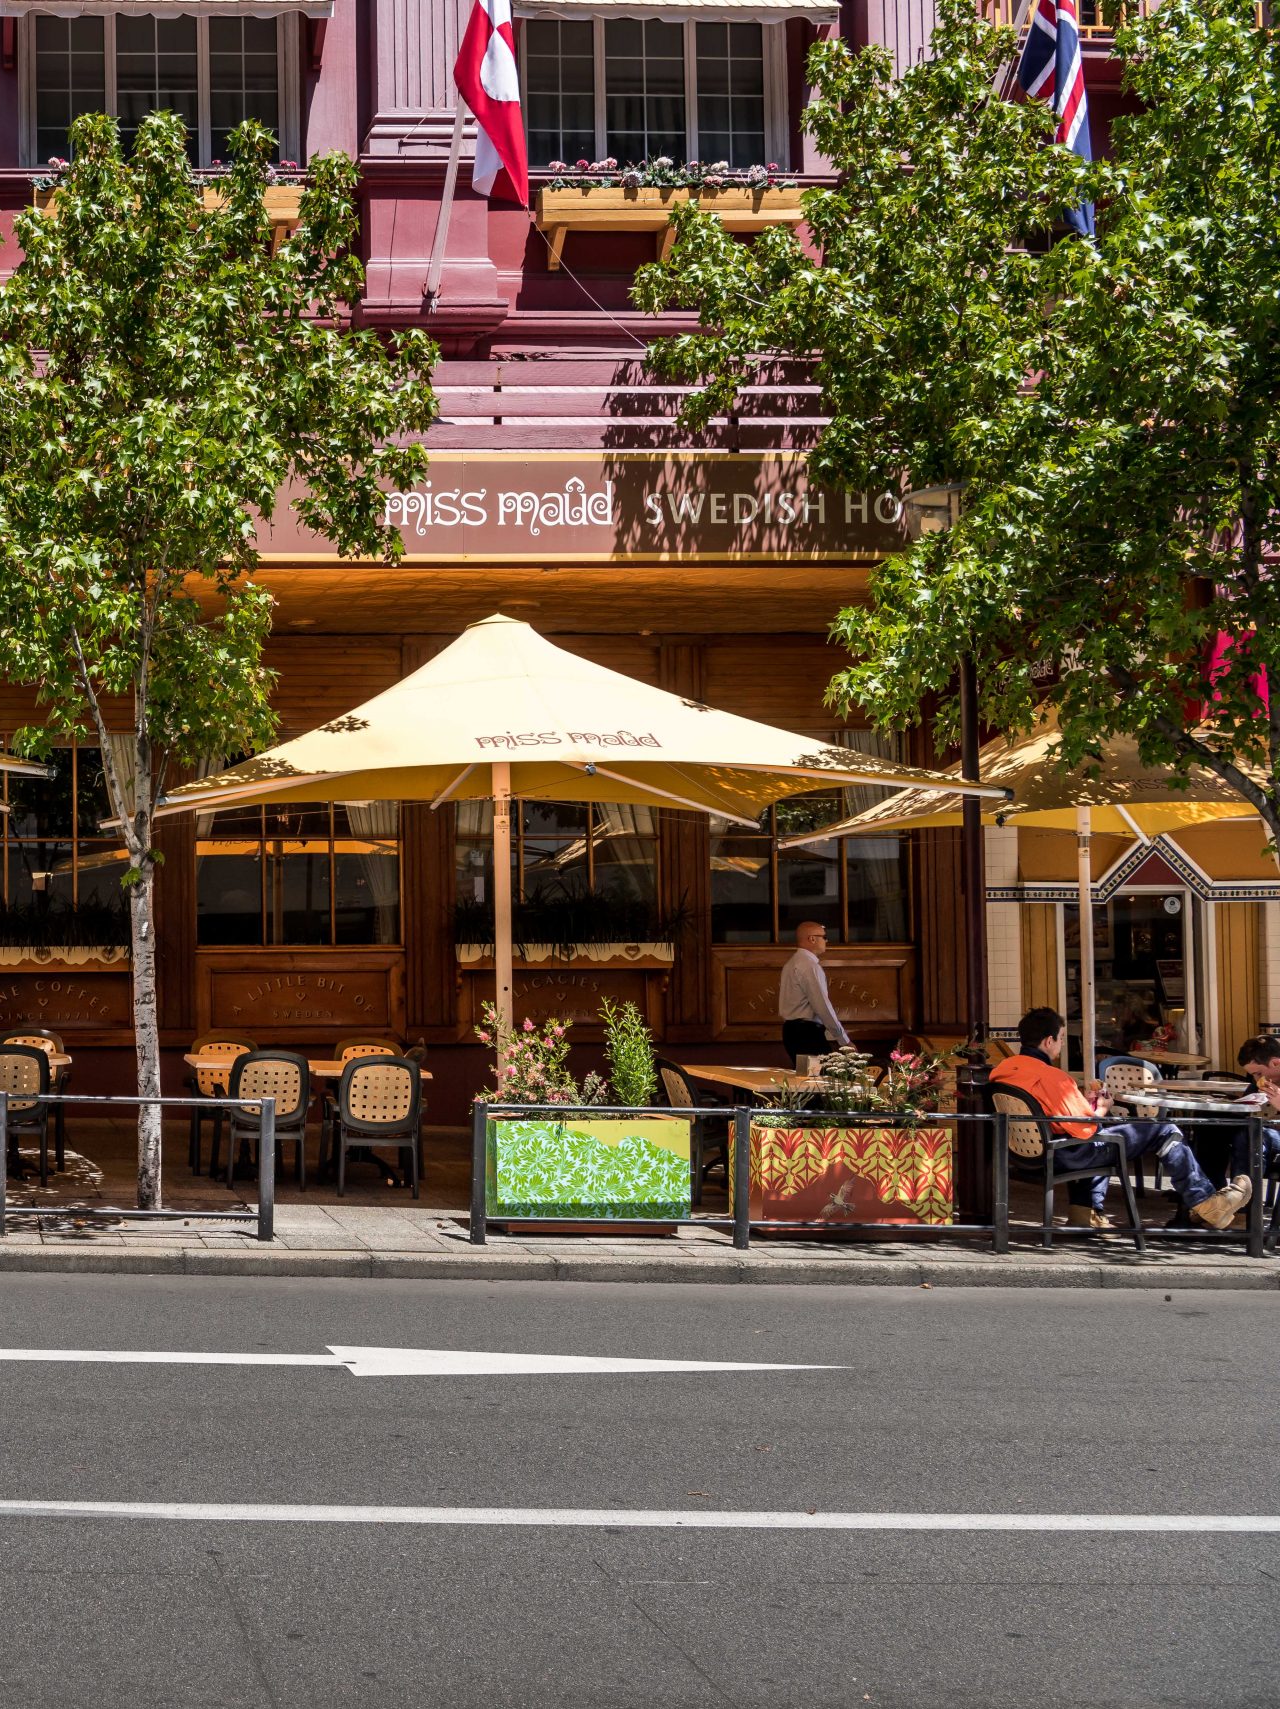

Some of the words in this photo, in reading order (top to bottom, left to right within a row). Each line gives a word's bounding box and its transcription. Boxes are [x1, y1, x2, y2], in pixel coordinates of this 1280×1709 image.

[645, 492, 826, 525] SWEDISH
[247, 975, 306, 1001] LITTLE
[316, 977, 345, 994] BIT
[353, 993, 375, 1013] OF
[513, 975, 600, 999] LICACIES
[748, 987, 777, 1010] FIN
[828, 977, 880, 1009] FFEES
[272, 1009, 334, 1019] SWEDEN
[532, 1008, 592, 1017] SWEDEN
